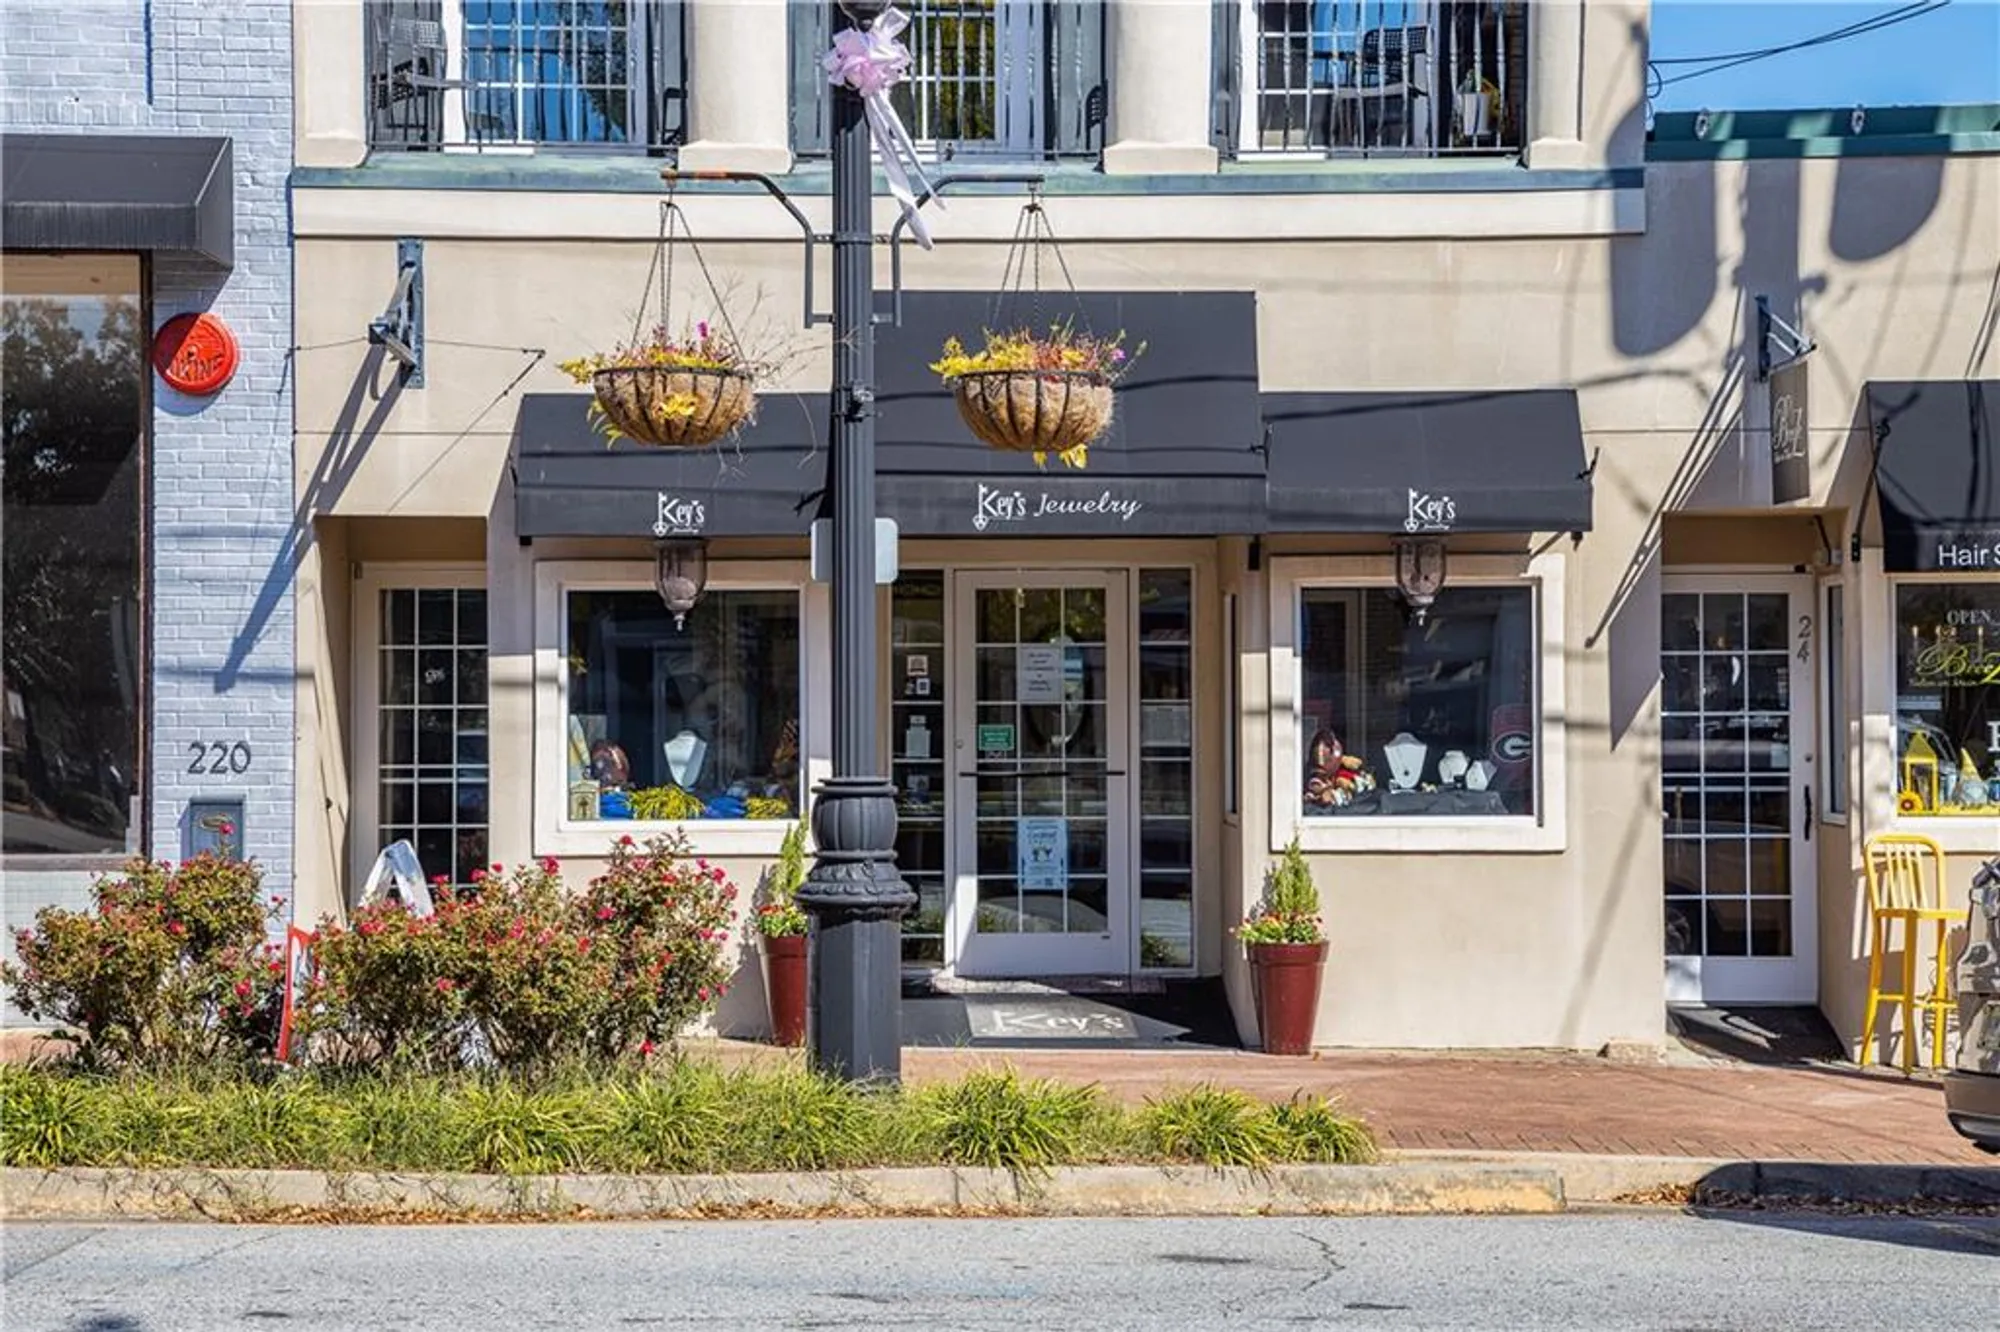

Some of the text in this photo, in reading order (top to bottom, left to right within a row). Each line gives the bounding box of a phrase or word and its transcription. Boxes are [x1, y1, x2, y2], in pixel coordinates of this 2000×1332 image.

[653, 492, 705, 536] Key's
[973, 484, 1142, 531] Key's Jewelry
[1404, 488, 1456, 532] Key's
[1938, 544, 1989, 566] Hair
[1947, 609, 1991, 625] OPEN
[1797, 615, 1811, 664] 24
[187, 741, 251, 774] 220
[990, 1010, 1125, 1032] Key's
